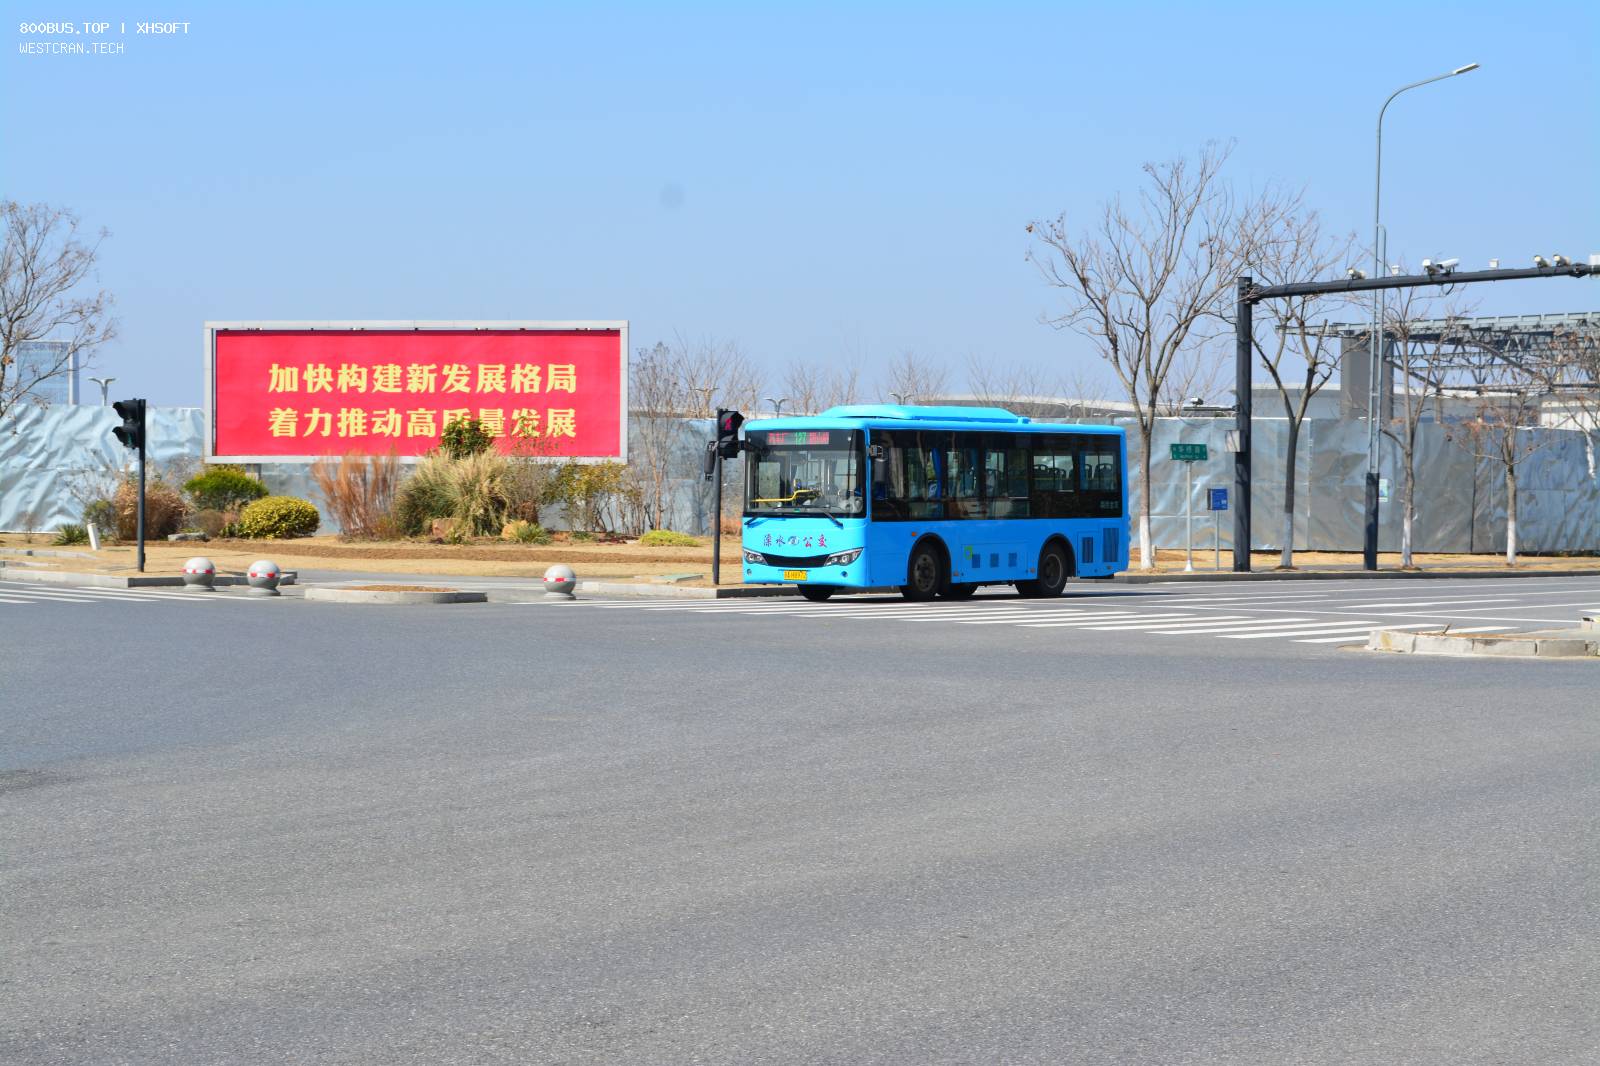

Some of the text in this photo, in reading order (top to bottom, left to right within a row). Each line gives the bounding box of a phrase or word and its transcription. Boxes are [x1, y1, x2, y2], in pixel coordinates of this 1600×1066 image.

[268, 363, 578, 394] 加快构建新发展格局
